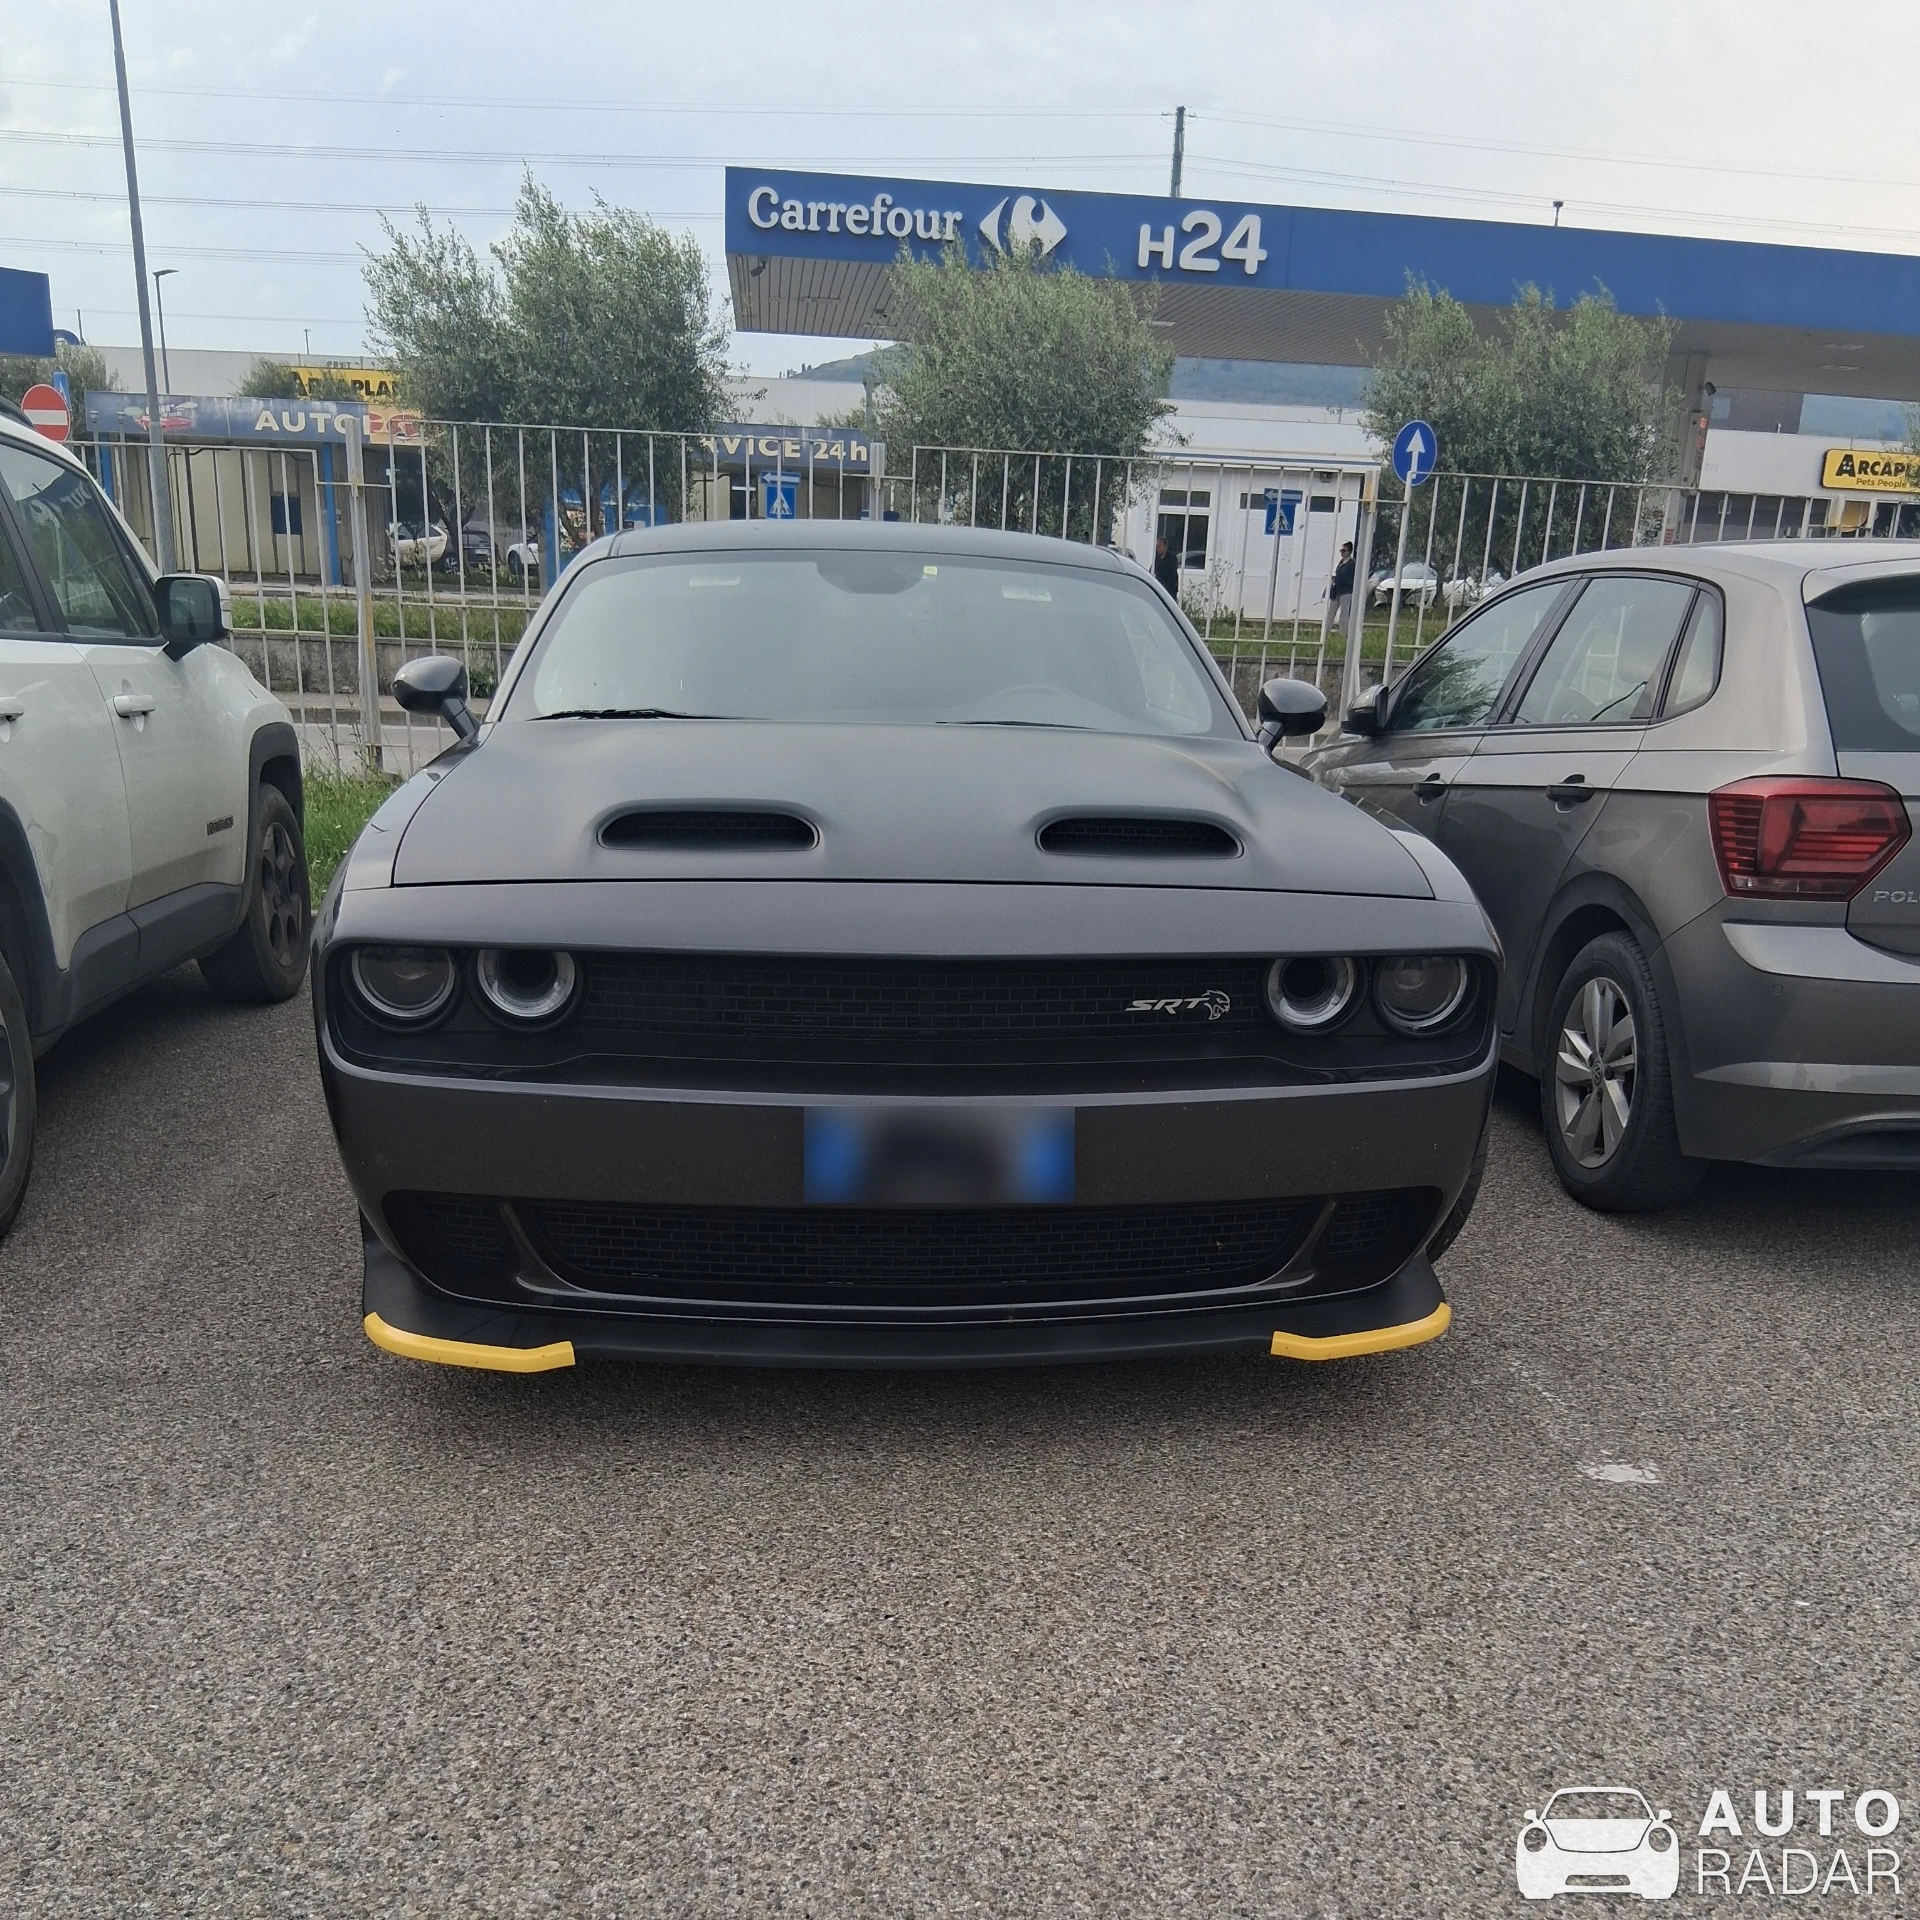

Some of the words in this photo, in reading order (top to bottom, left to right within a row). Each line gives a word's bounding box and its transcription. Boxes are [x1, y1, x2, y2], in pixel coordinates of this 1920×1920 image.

[747, 185, 964, 242] Carrefour
[1136, 209, 1268, 275] H24
[813, 438, 868, 462] 24h
[1835, 453, 1912, 478] ARCAP
[1856, 477, 1875, 487] Pets
[1877, 479, 1907, 489] People
[1872, 890, 1920, 904] POL
[1125, 997, 1210, 1015] SRT
